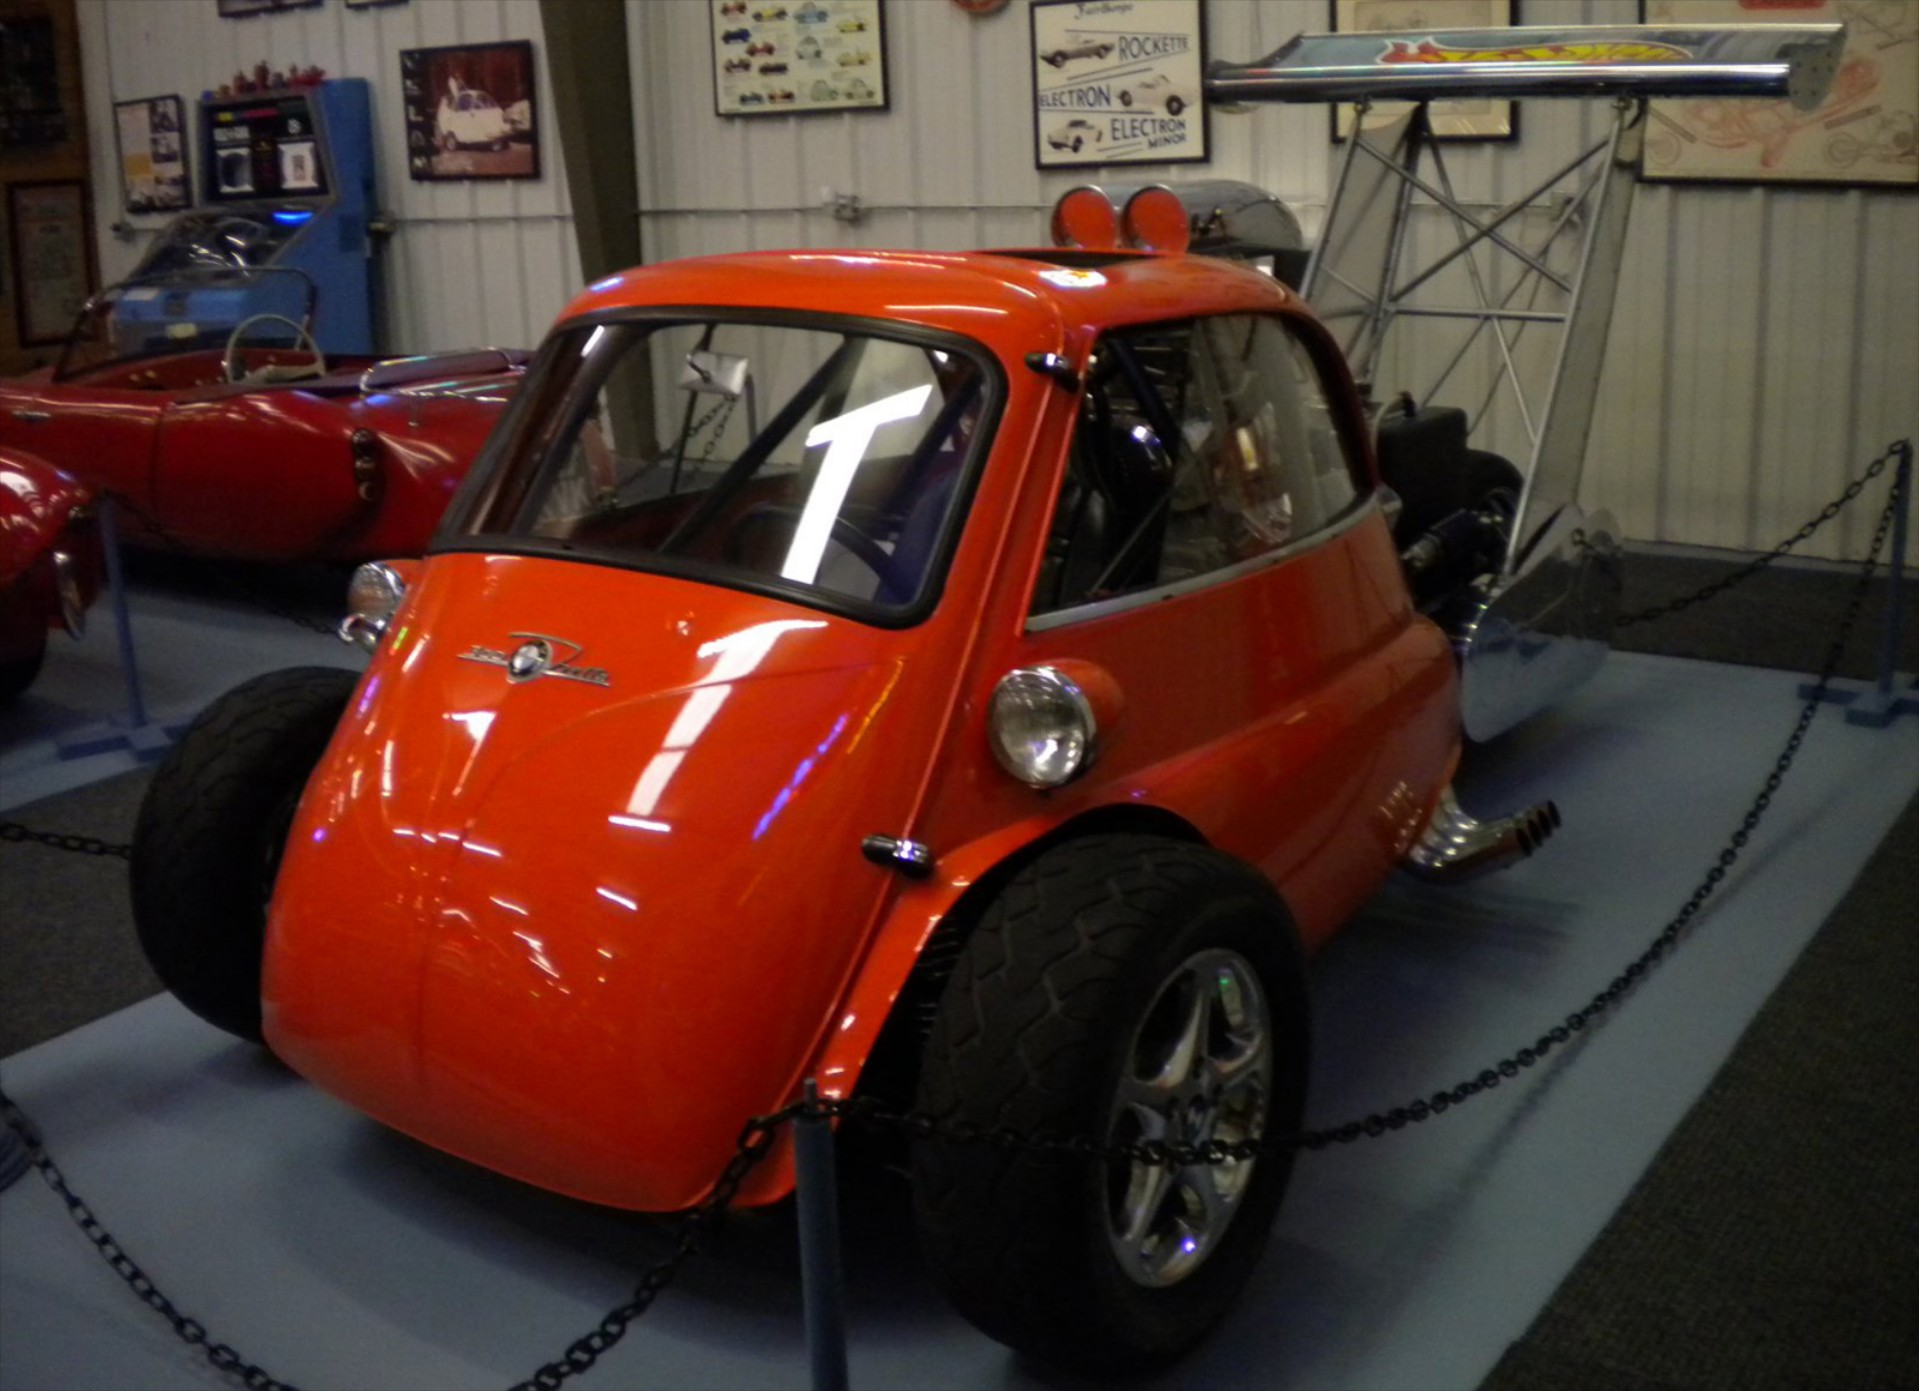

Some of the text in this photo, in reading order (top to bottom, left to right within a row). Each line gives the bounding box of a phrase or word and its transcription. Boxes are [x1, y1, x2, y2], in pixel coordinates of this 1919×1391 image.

[1118, 36, 1189, 61] ROCKETTE
[1039, 84, 1112, 108] ELECTRON
[1110, 118, 1187, 141] ELECTRON
[1147, 132, 1187, 150] MINOR
